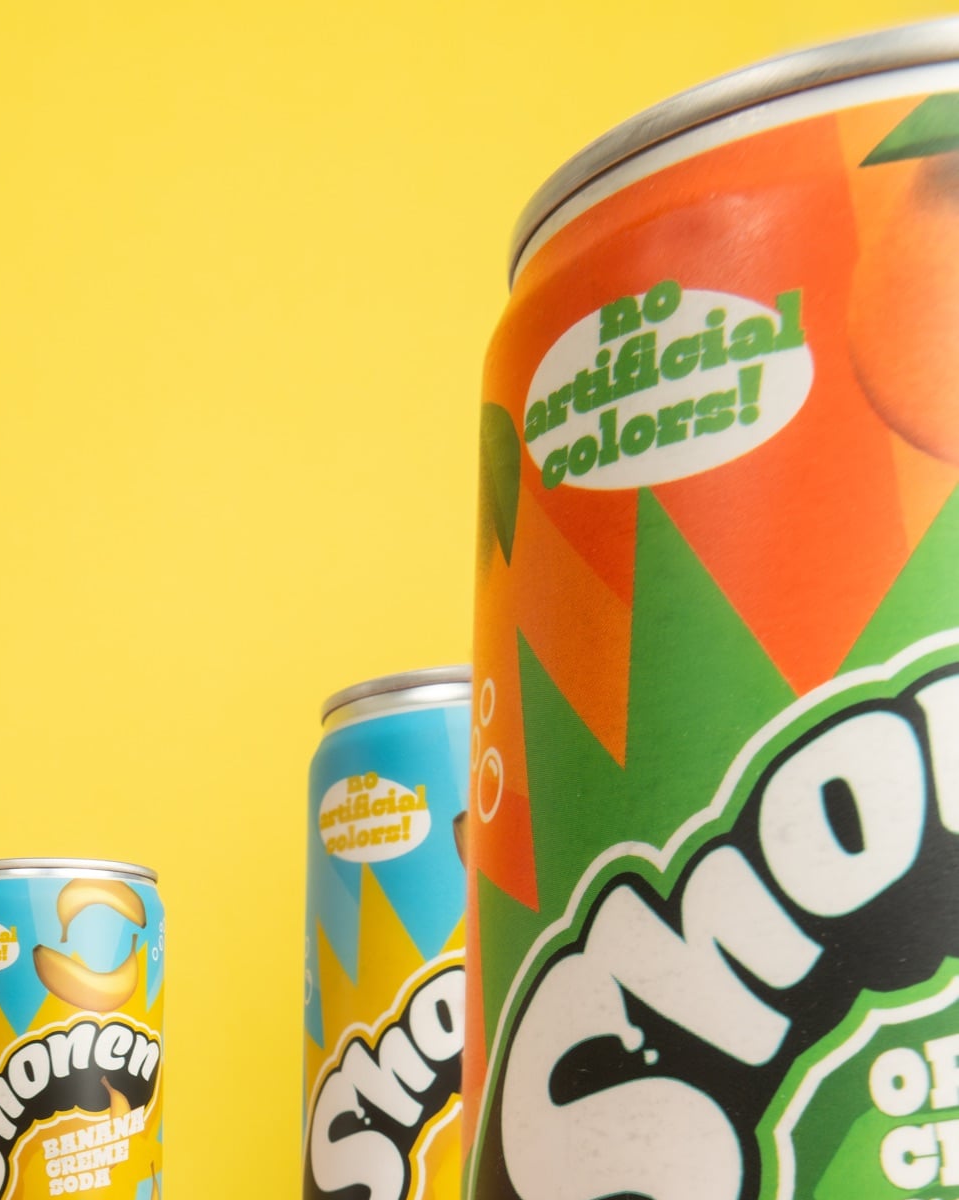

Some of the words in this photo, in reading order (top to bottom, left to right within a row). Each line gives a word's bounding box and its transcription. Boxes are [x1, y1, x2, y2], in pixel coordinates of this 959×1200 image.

[599, 279, 682, 346] no
[524, 287, 805, 444] artificial
[541, 363, 764, 490] colors!
[347, 772, 379, 794] no
[321, 784, 428, 830] artificial
[326, 815, 411, 855] colors!
[42, 1105, 145, 1160] BANANA
[46, 1138, 130, 1178] CREME
[49, 1167, 112, 1196] SODA
